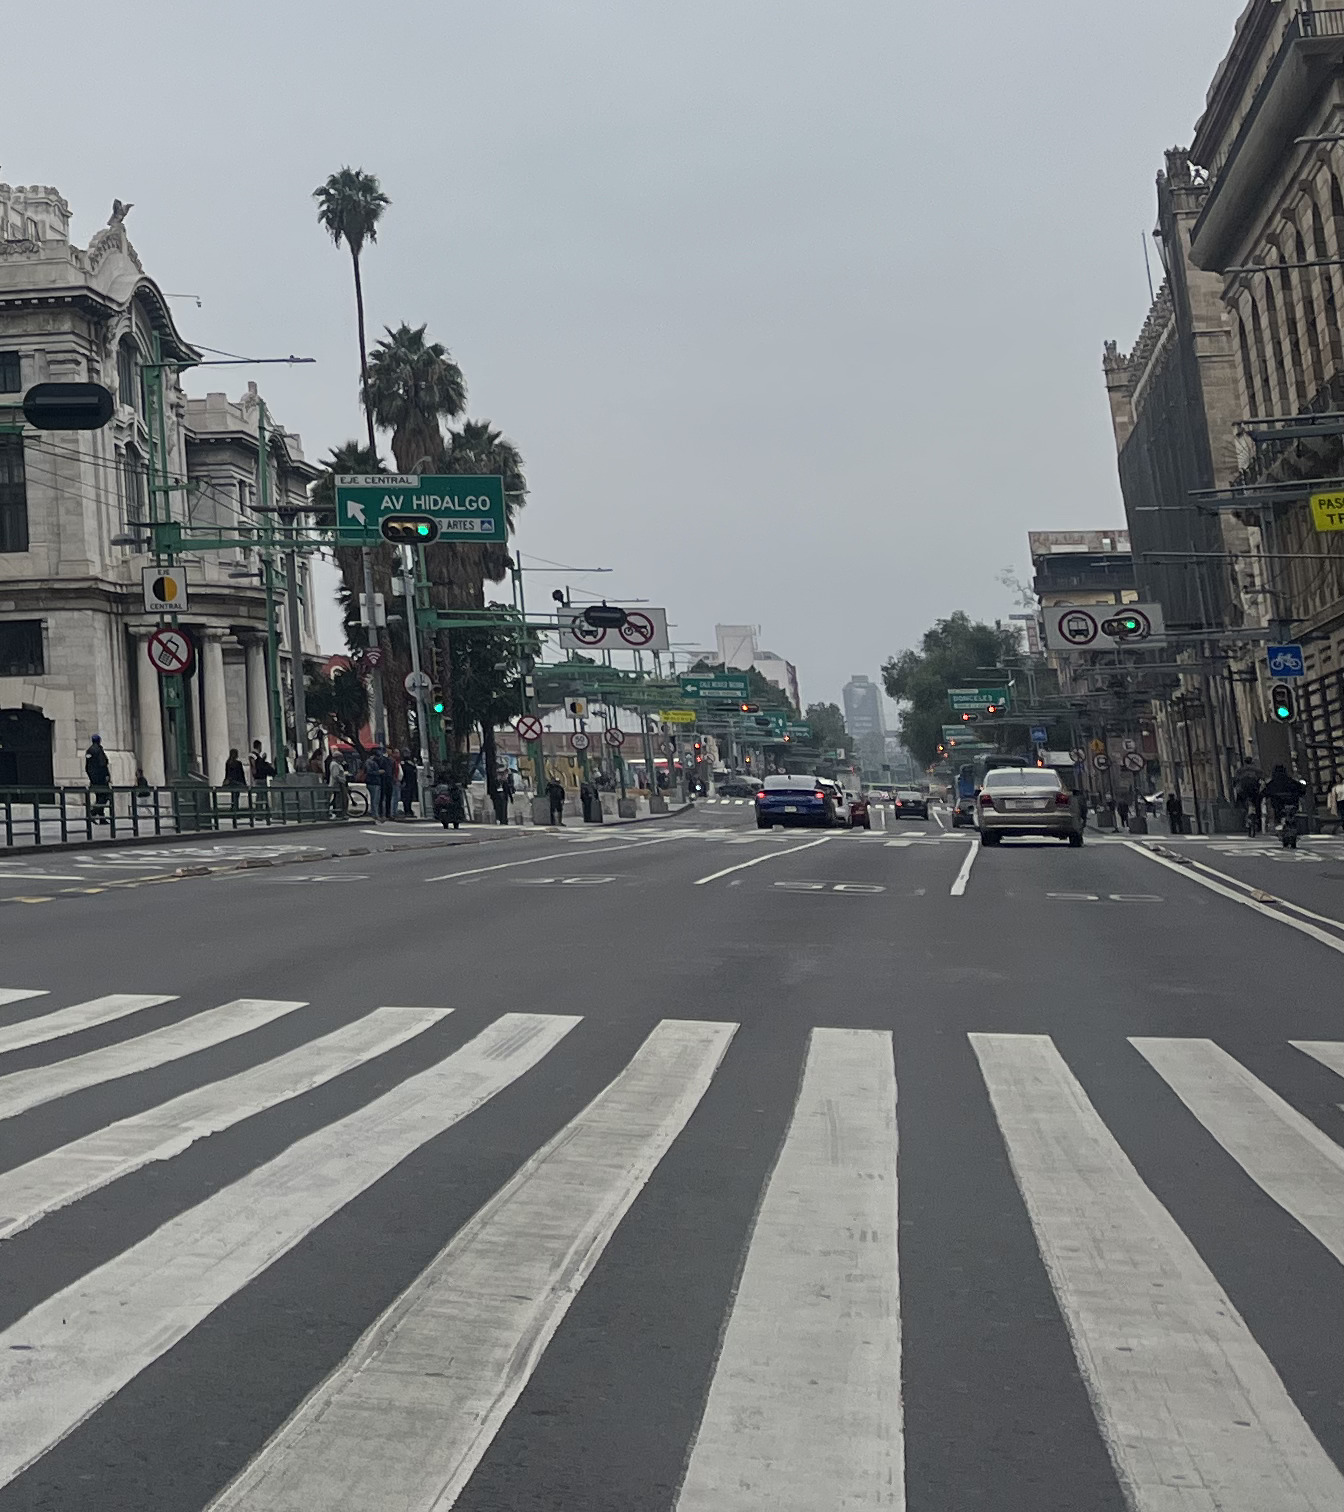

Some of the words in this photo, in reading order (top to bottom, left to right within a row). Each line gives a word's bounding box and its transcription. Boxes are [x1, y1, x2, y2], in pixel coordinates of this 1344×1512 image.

[340, 476, 360, 485] EJE
[364, 476, 413, 485] CENTRAL
[380, 495, 404, 510] AV
[413, 495, 491, 511] HIDALGO
[446, 519, 475, 531] ARTES
